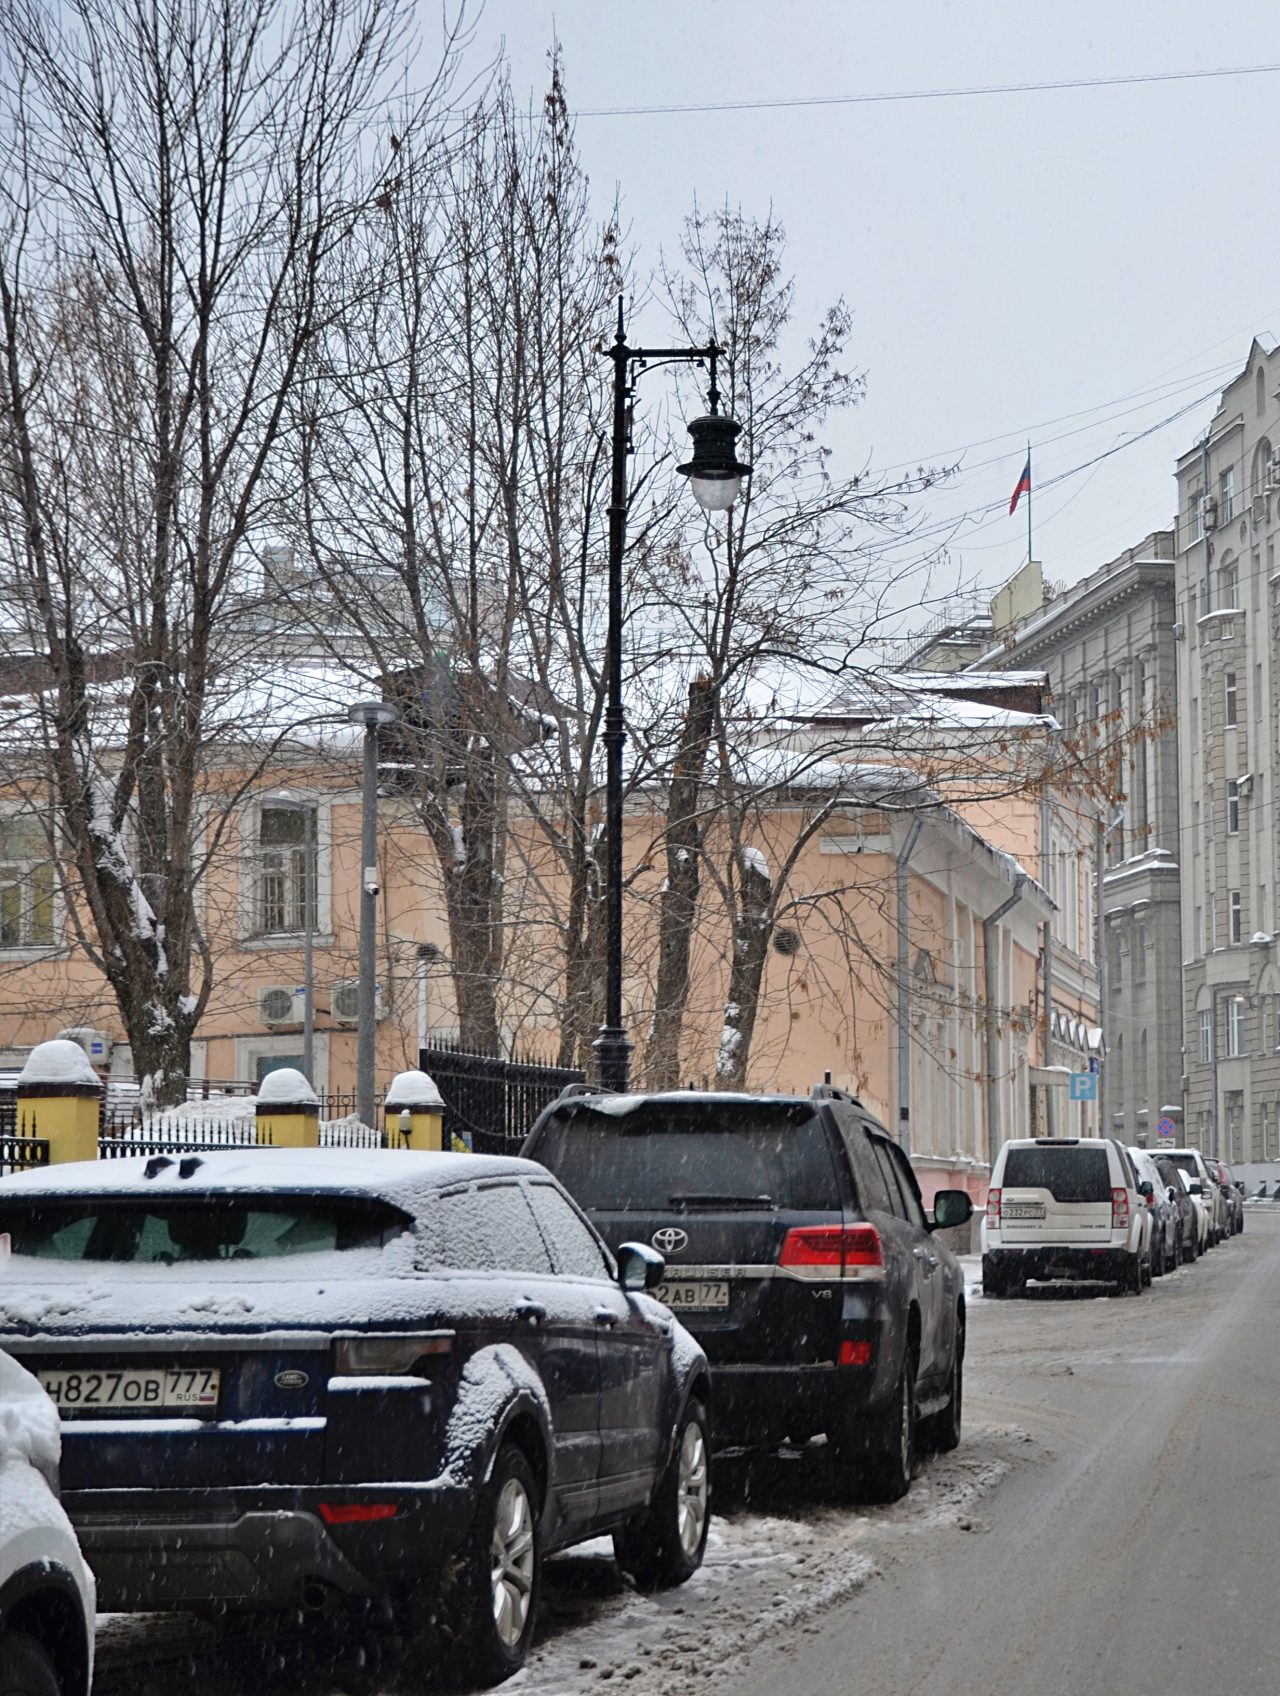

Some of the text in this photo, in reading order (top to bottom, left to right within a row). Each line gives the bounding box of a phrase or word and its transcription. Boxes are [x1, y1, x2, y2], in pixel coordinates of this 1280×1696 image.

[1075, 1076, 1091, 1097] P
[703, 1284, 722, 1299] 77
[811, 1289, 833, 1299] V8
[168, 1370, 213, 1394] 777
[176, 1393, 199, 1402] RUS
